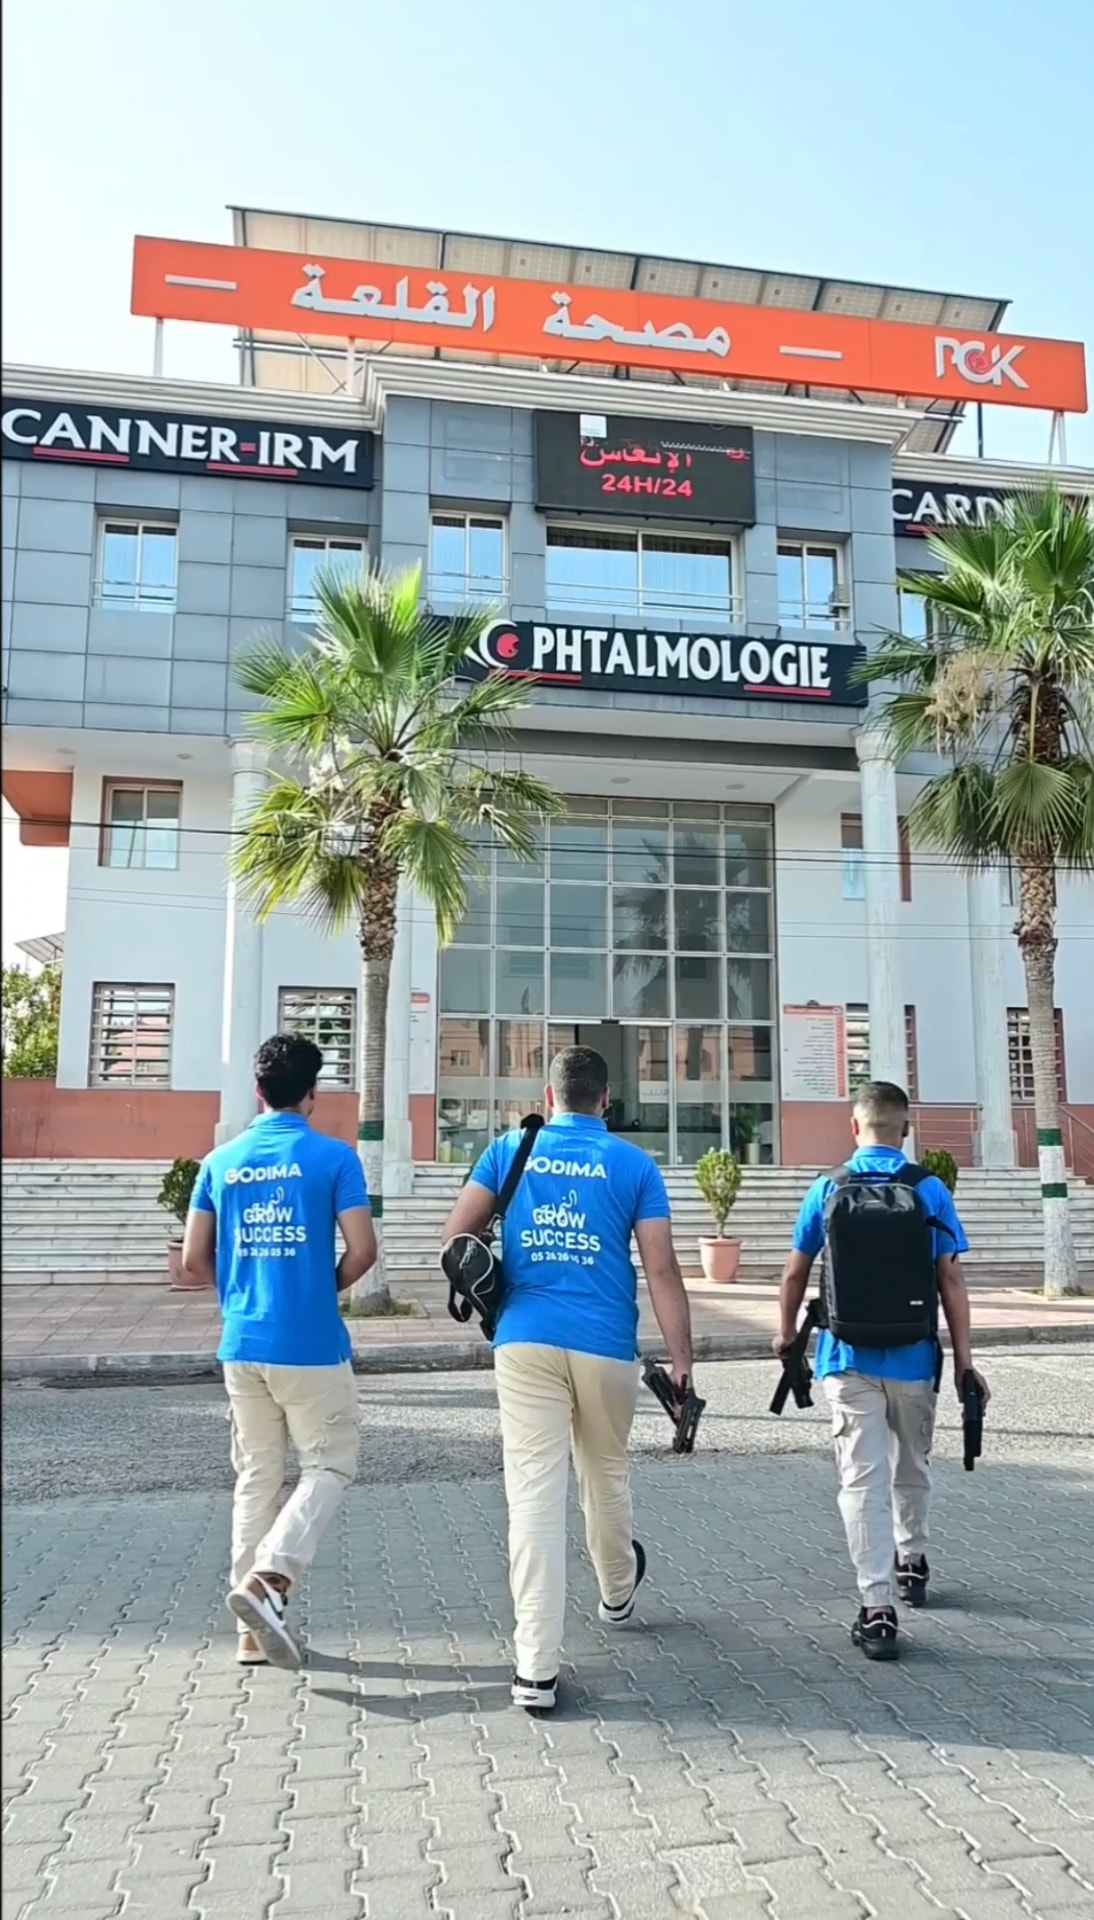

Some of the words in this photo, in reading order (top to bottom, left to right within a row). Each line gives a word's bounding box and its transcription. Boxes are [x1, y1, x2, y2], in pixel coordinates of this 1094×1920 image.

[291, 263, 496, 333] القلعة
[542, 291, 731, 357] مصحة
[601, 473, 693, 498] 24H/24
[225, 1163, 302, 1185] GODIMA
[243, 1206, 293, 1224] GROW
[532, 1207, 586, 1229] GROW
[234, 1225, 306, 1243] SUCCESS
[521, 1229, 601, 1252] SUCCESS
